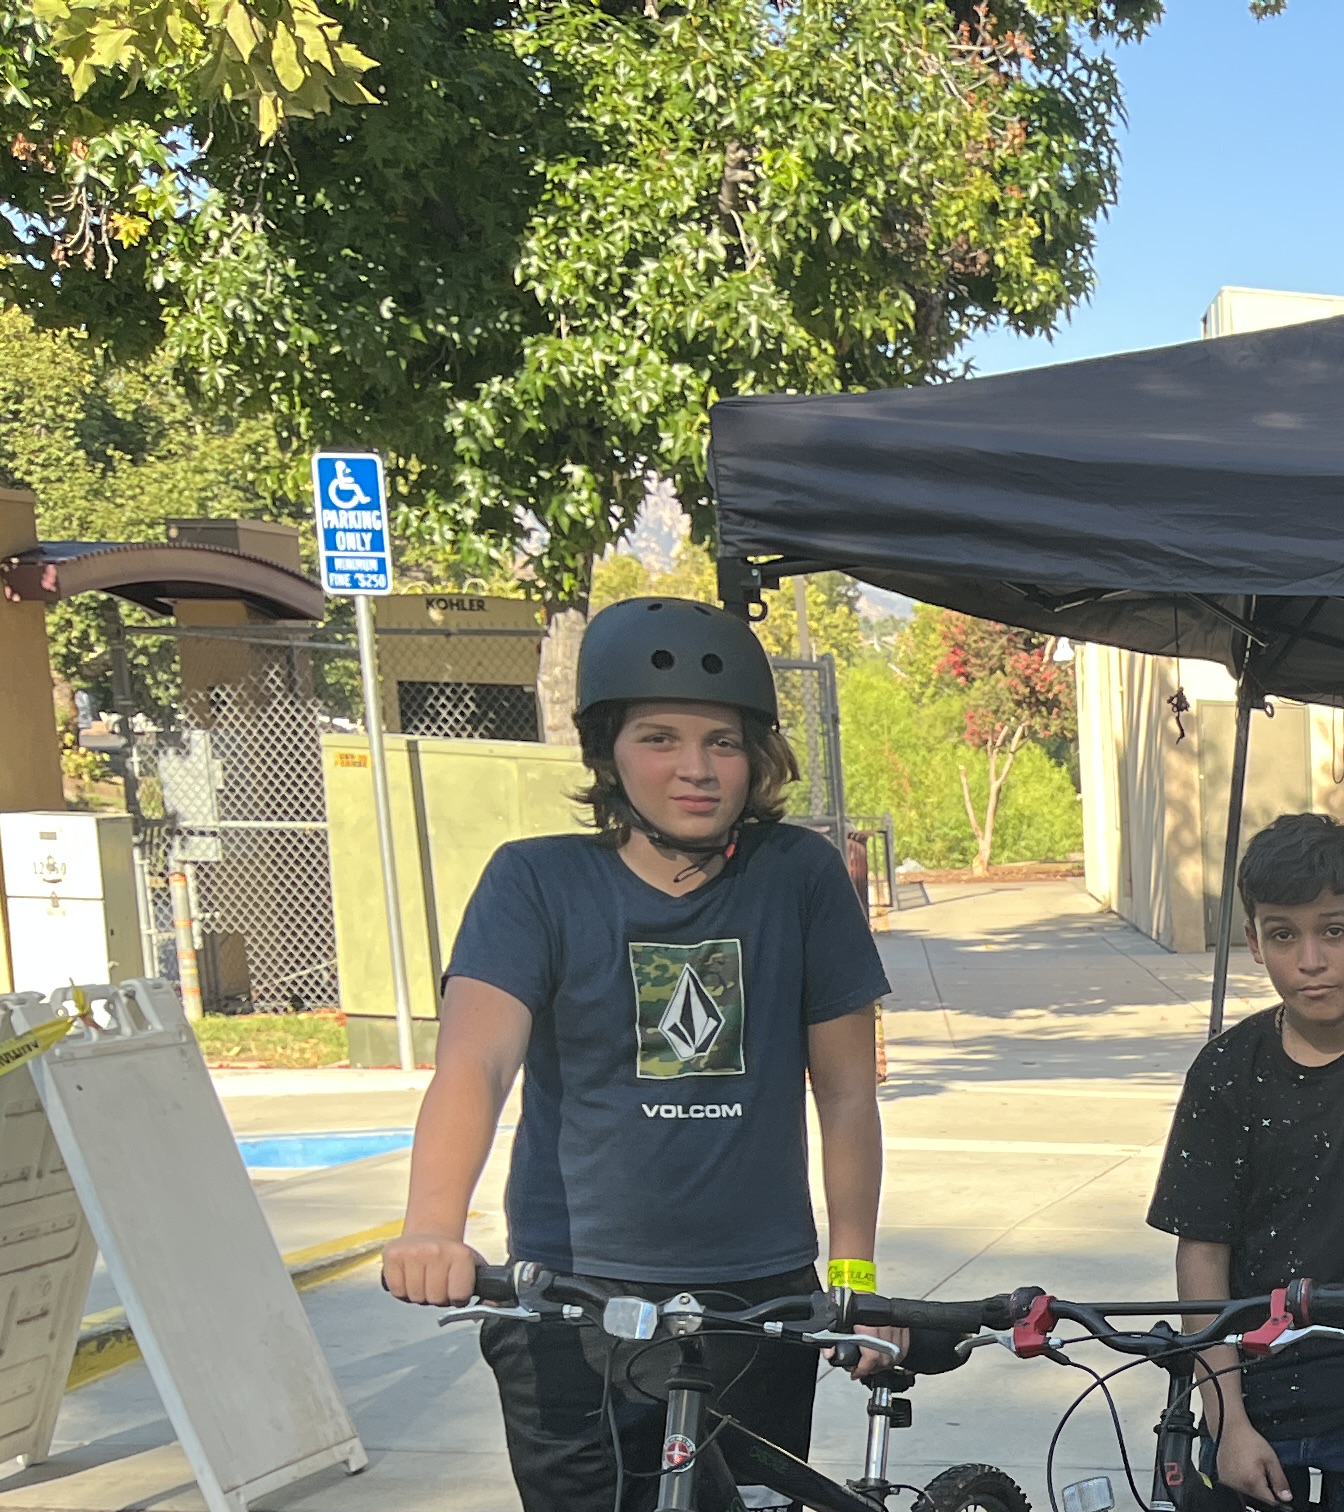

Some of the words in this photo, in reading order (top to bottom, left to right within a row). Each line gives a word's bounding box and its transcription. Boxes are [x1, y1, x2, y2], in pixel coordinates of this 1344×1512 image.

[322, 509, 382, 531] PARKING
[335, 531, 373, 551] ONLY
[329, 573, 352, 587] FINE
[425, 597, 488, 611] KOHLER
[641, 1103, 742, 1118] VOLCOM
